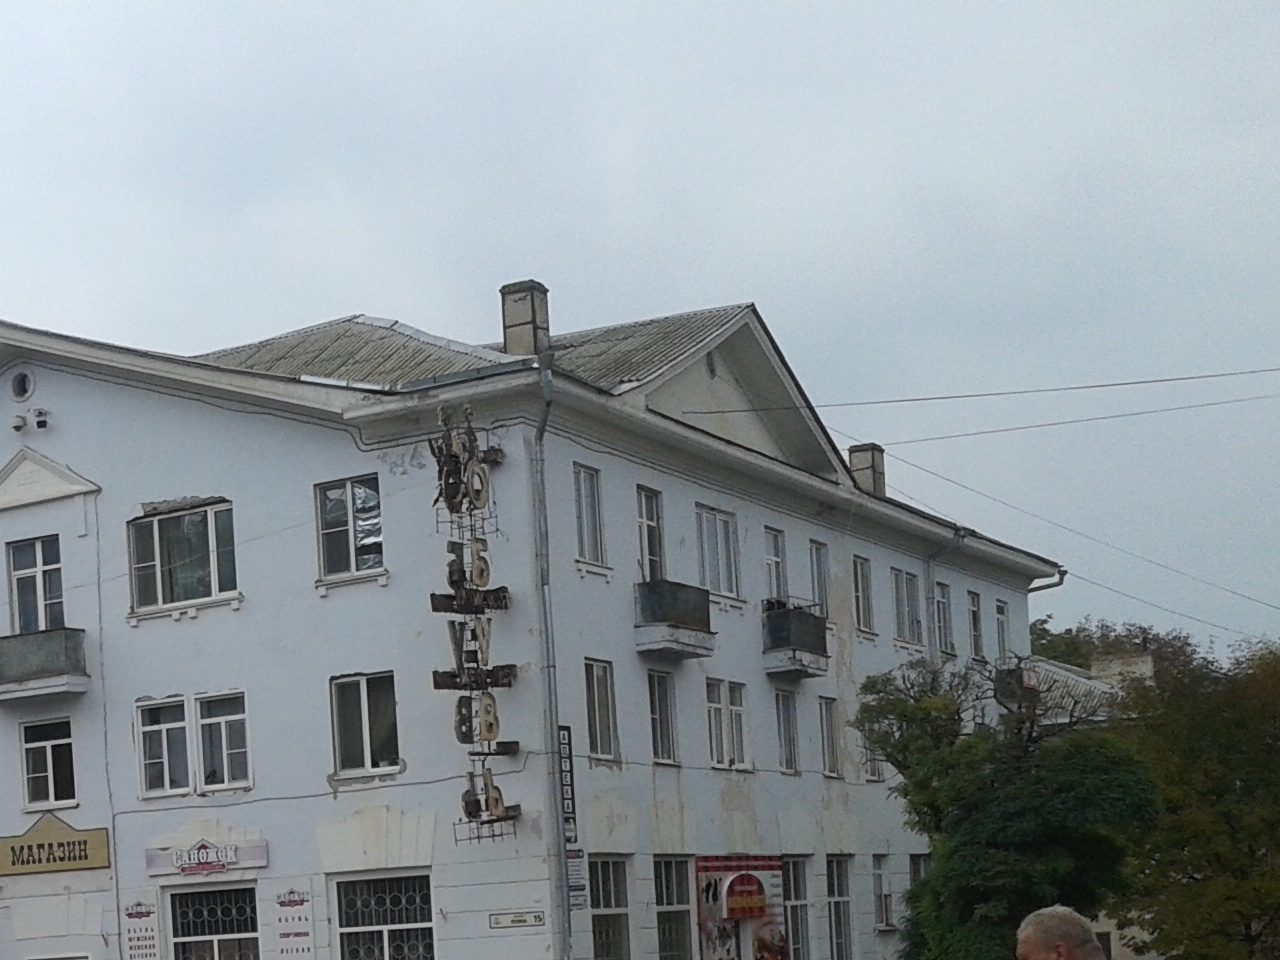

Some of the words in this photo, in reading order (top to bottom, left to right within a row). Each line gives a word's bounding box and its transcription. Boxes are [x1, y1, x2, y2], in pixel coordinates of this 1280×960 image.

[561, 731, 573, 812] АПТЕКА
[10, 839, 89, 866] МАГАЗИН
[533, 914, 543, 923] 15
